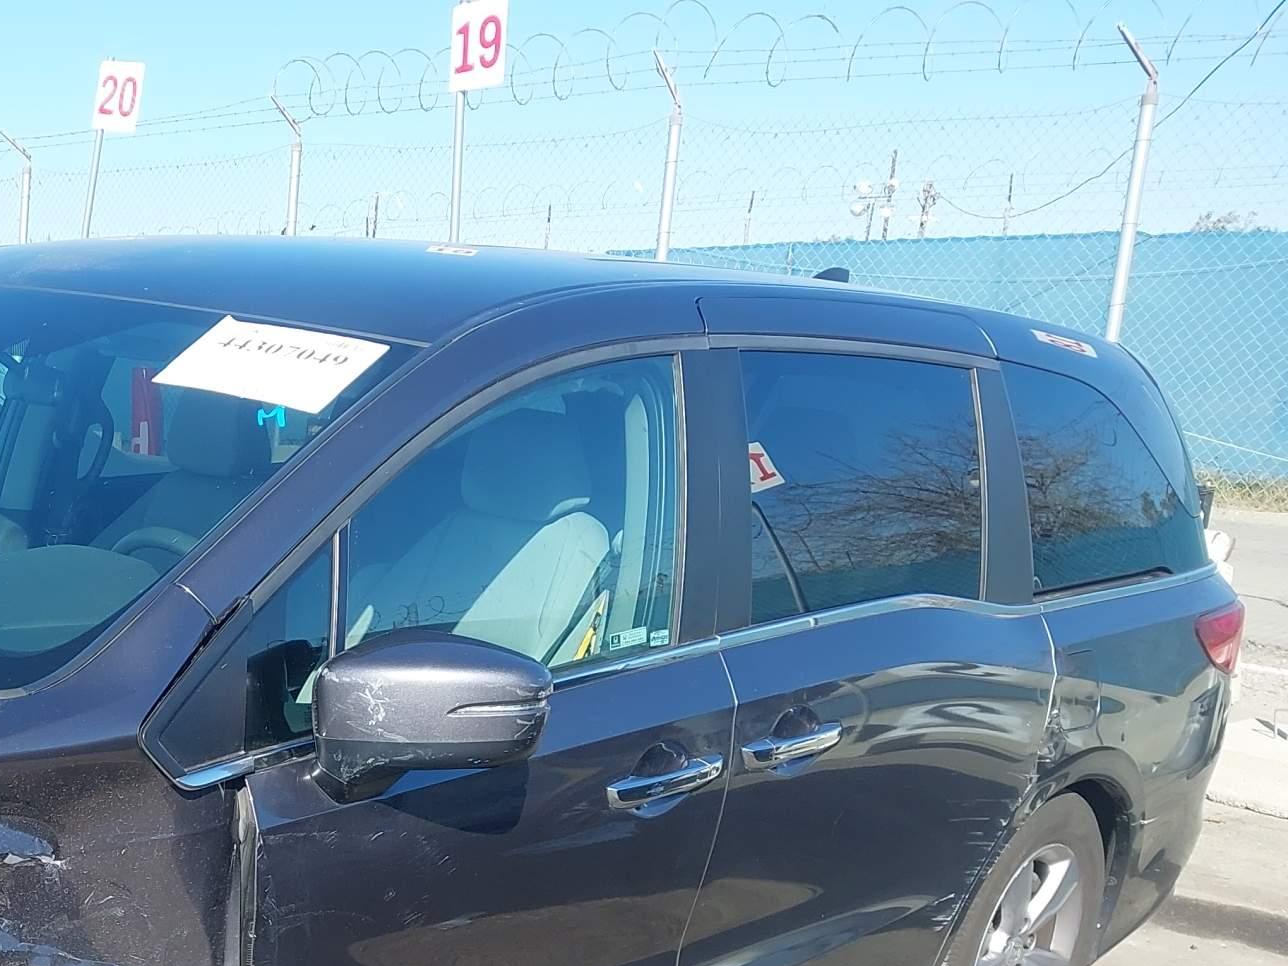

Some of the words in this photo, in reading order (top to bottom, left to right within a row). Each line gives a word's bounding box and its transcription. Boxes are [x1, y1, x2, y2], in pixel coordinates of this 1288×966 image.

[455, 15, 502, 74] 19
[99, 75, 137, 117] 20
[217, 337, 349, 366] 44307049
